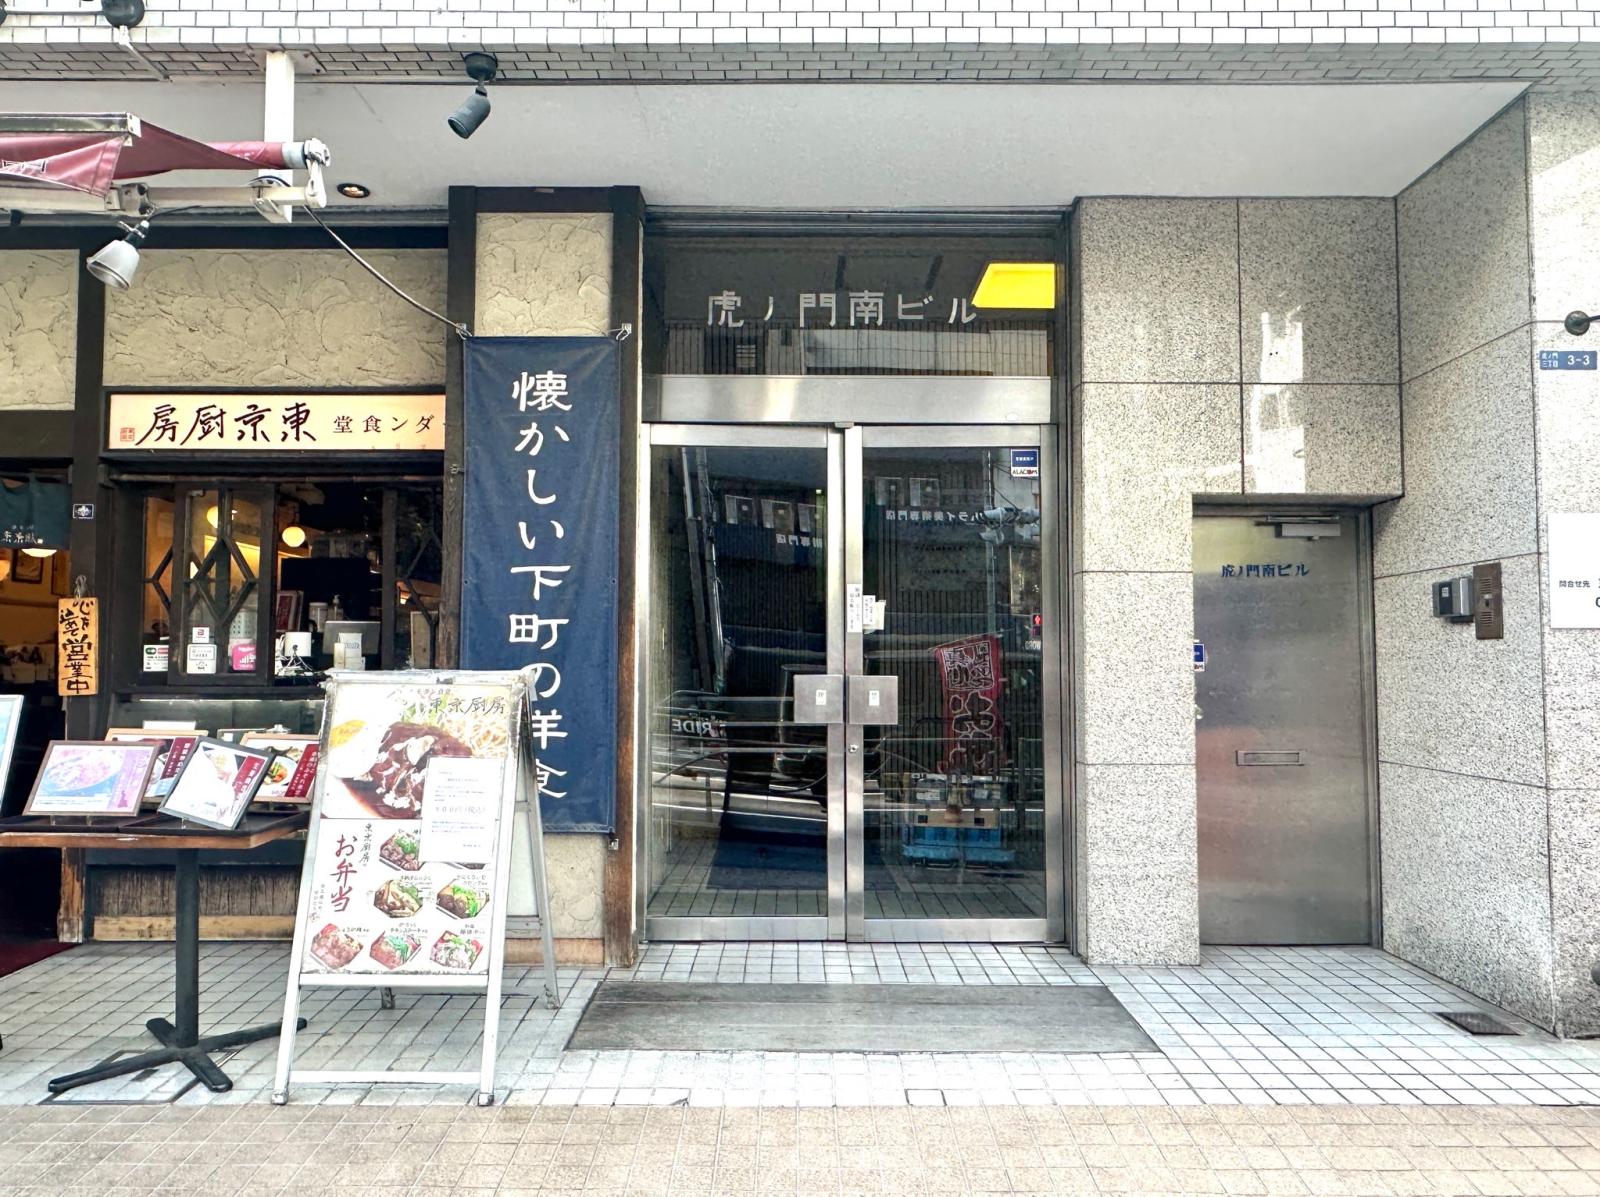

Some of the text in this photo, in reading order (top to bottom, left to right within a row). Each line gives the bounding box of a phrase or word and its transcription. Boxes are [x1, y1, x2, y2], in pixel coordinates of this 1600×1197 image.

[708, 290, 977, 328] 虎ノ門南ビル
[1567, 354, 1590, 366] 3-3
[333, 414, 446, 434] ダン食堂
[1221, 564, 1310, 578] 虎ノ門南ビル
[1559, 580, 1591, 588] 問合せ先
[61, 633, 94, 694] 営業中
[330, 834, 358, 912] お弁当
